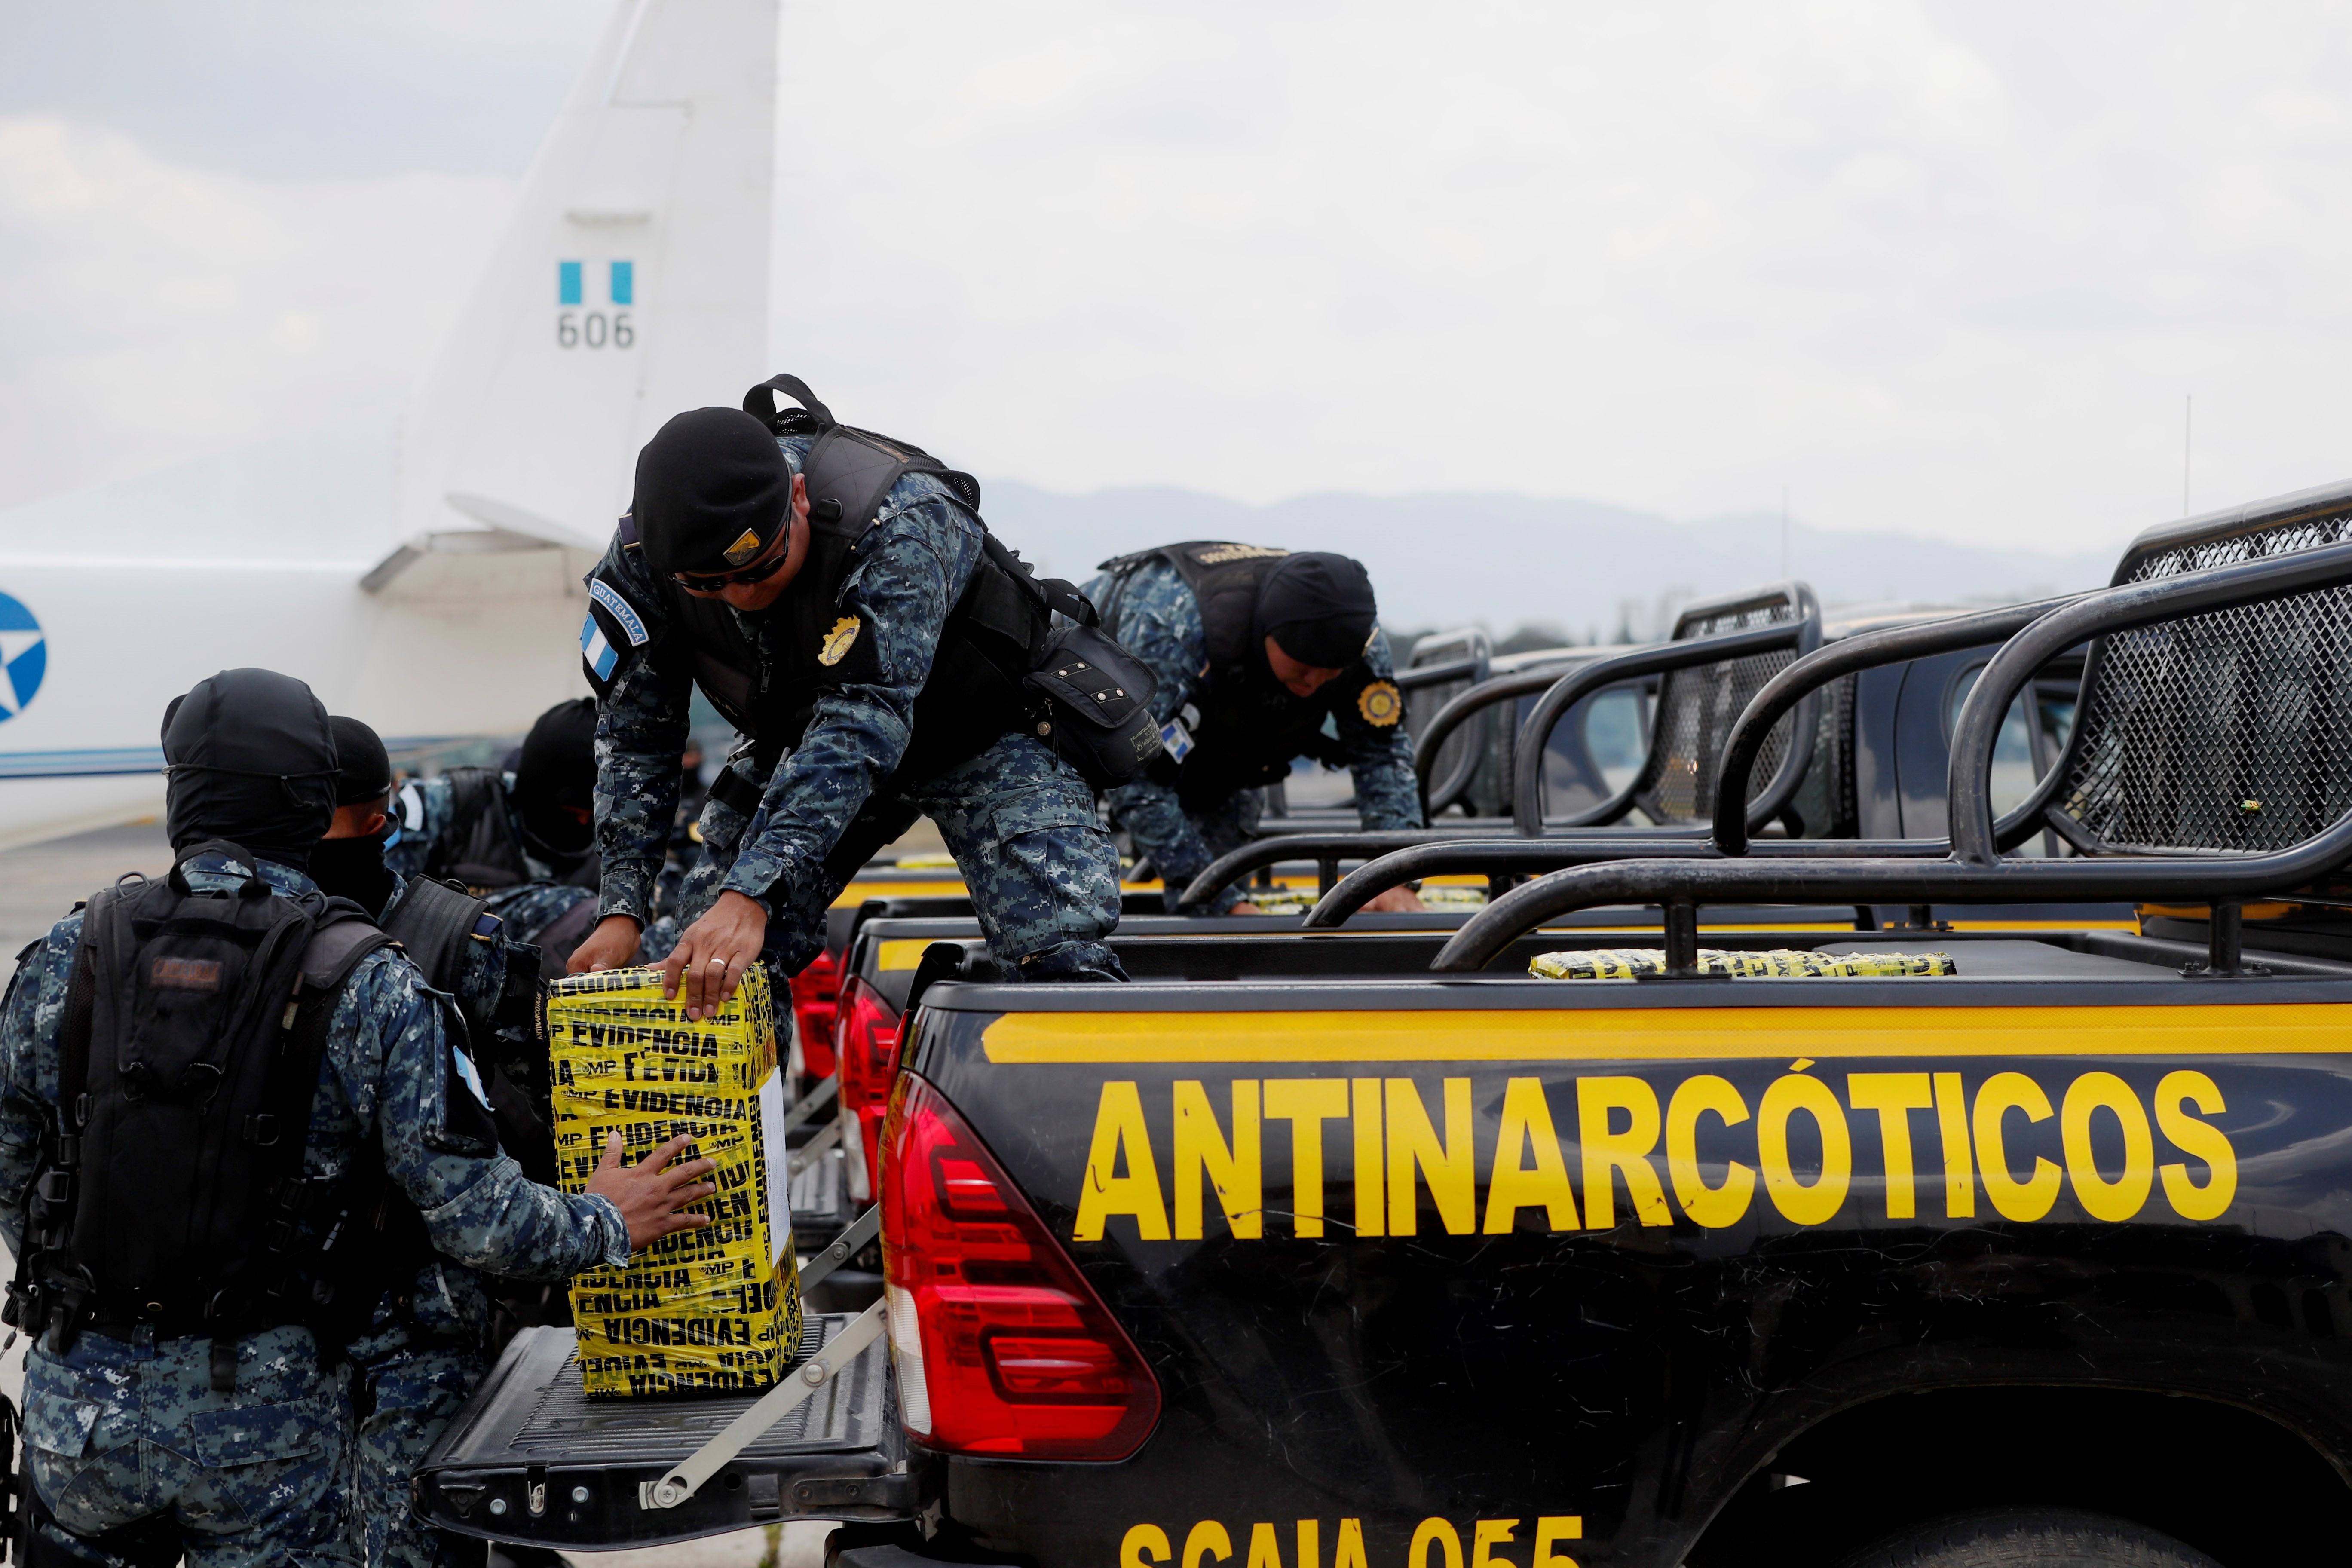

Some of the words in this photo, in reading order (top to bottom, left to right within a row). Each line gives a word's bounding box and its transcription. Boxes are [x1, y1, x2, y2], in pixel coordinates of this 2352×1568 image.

[559, 312, 634, 349] 606
[593, 585, 643, 642] GUATEMALA
[710, 1015, 740, 1026] MP
[573, 1021, 718, 1058] EVIDENCIA
[587, 1060, 616, 1075] MP
[1073, 1058, 2238, 1241] ANTINARCÓTICOS
[705, 1262, 735, 1275] MP
[603, 1317, 750, 1346] EVIDENCIA
[628, 1369, 775, 1396] EVIDENCIA
